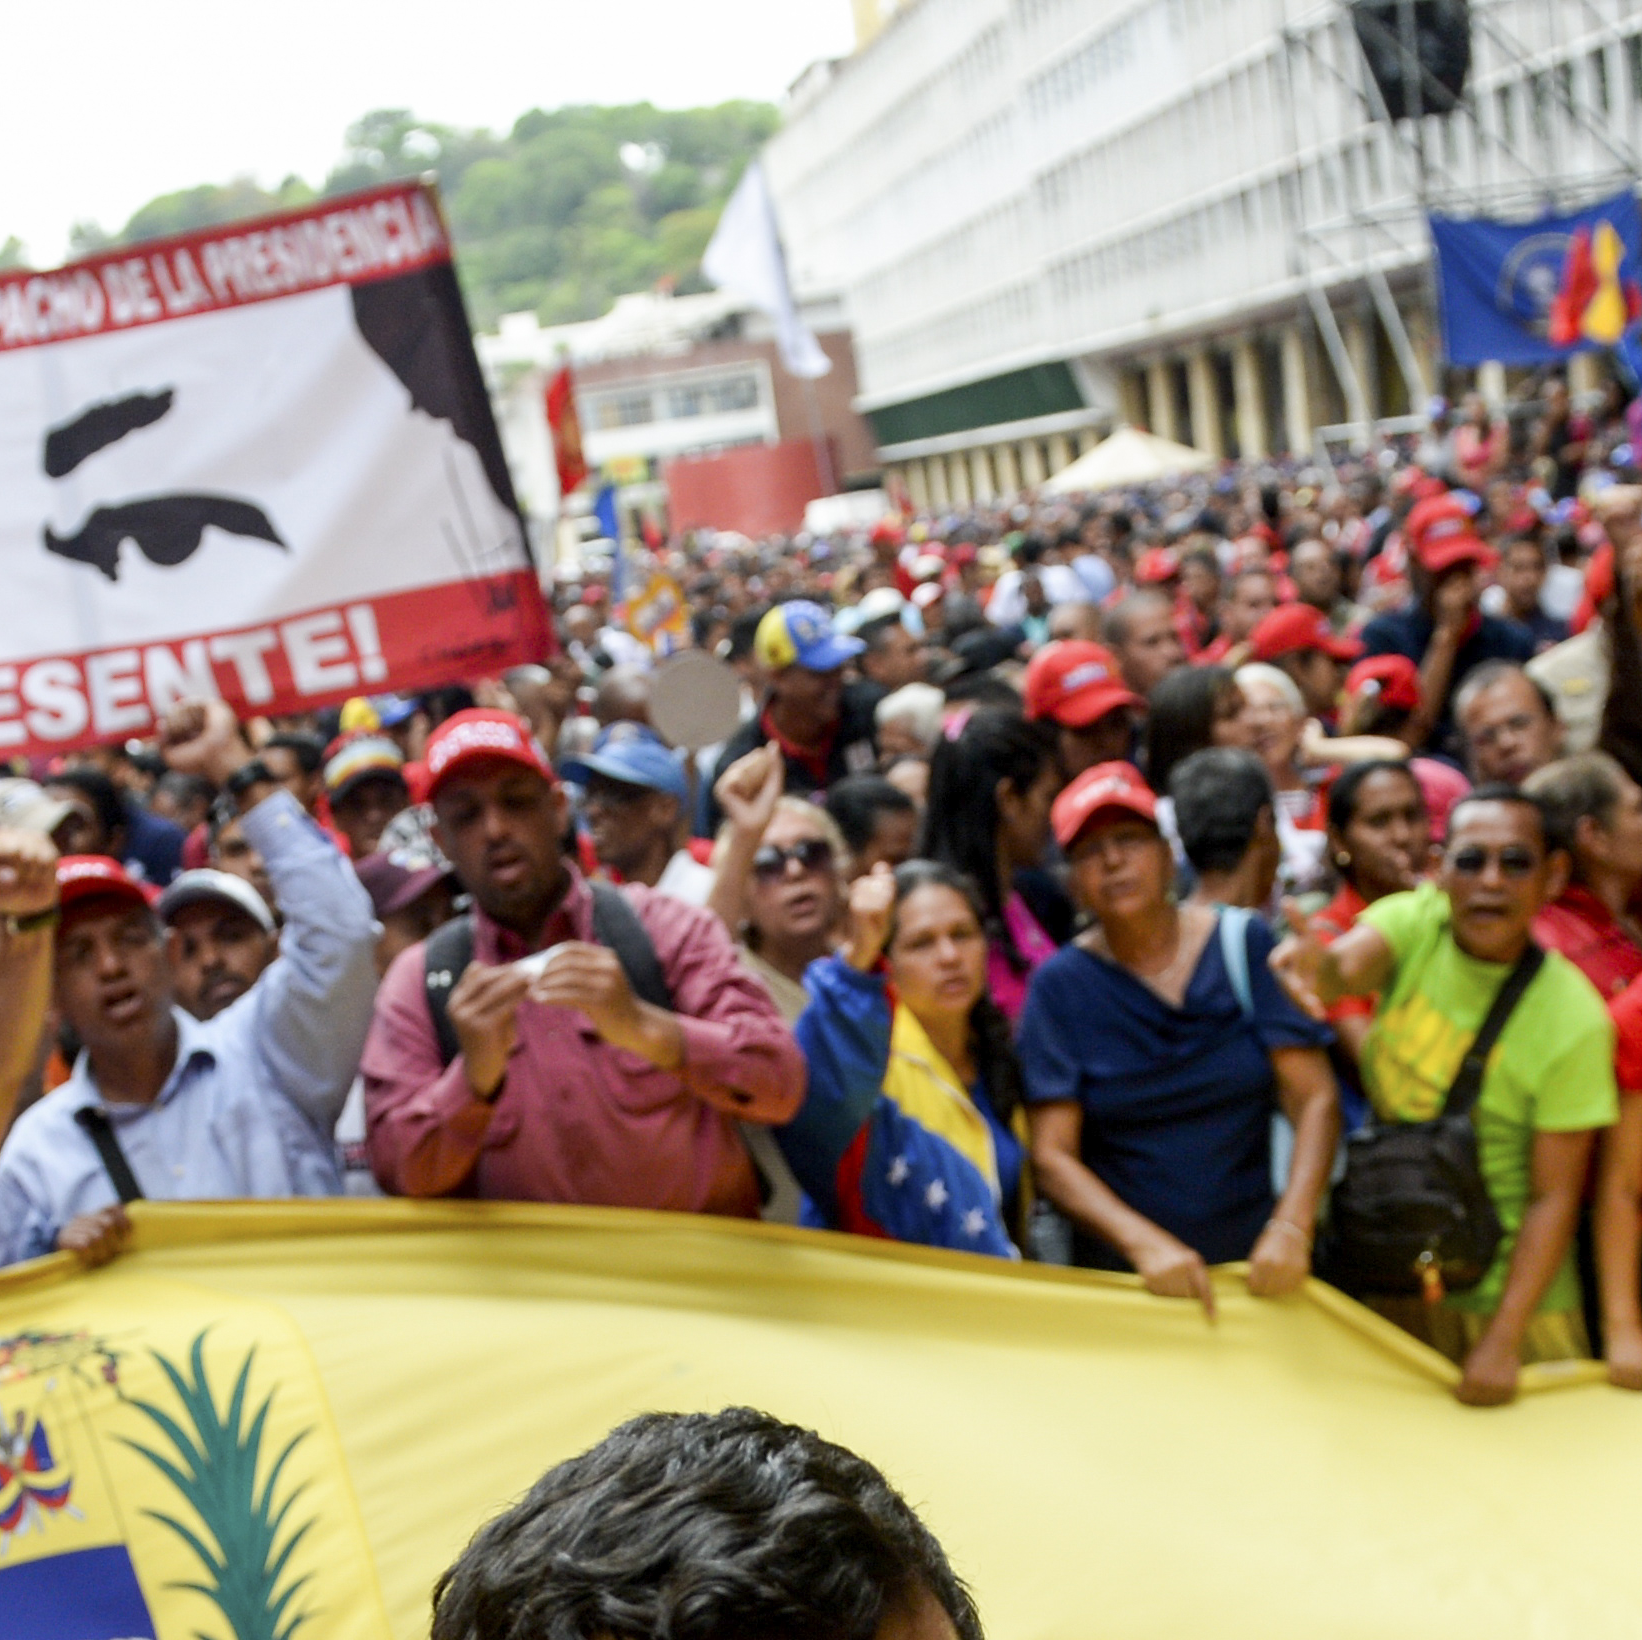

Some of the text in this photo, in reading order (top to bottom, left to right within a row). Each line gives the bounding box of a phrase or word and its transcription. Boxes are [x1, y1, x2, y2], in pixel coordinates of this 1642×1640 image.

[103, 256, 157, 325] DE
[155, 247, 213, 313] LA
[201, 192, 447, 300] PRESIDENCIA
